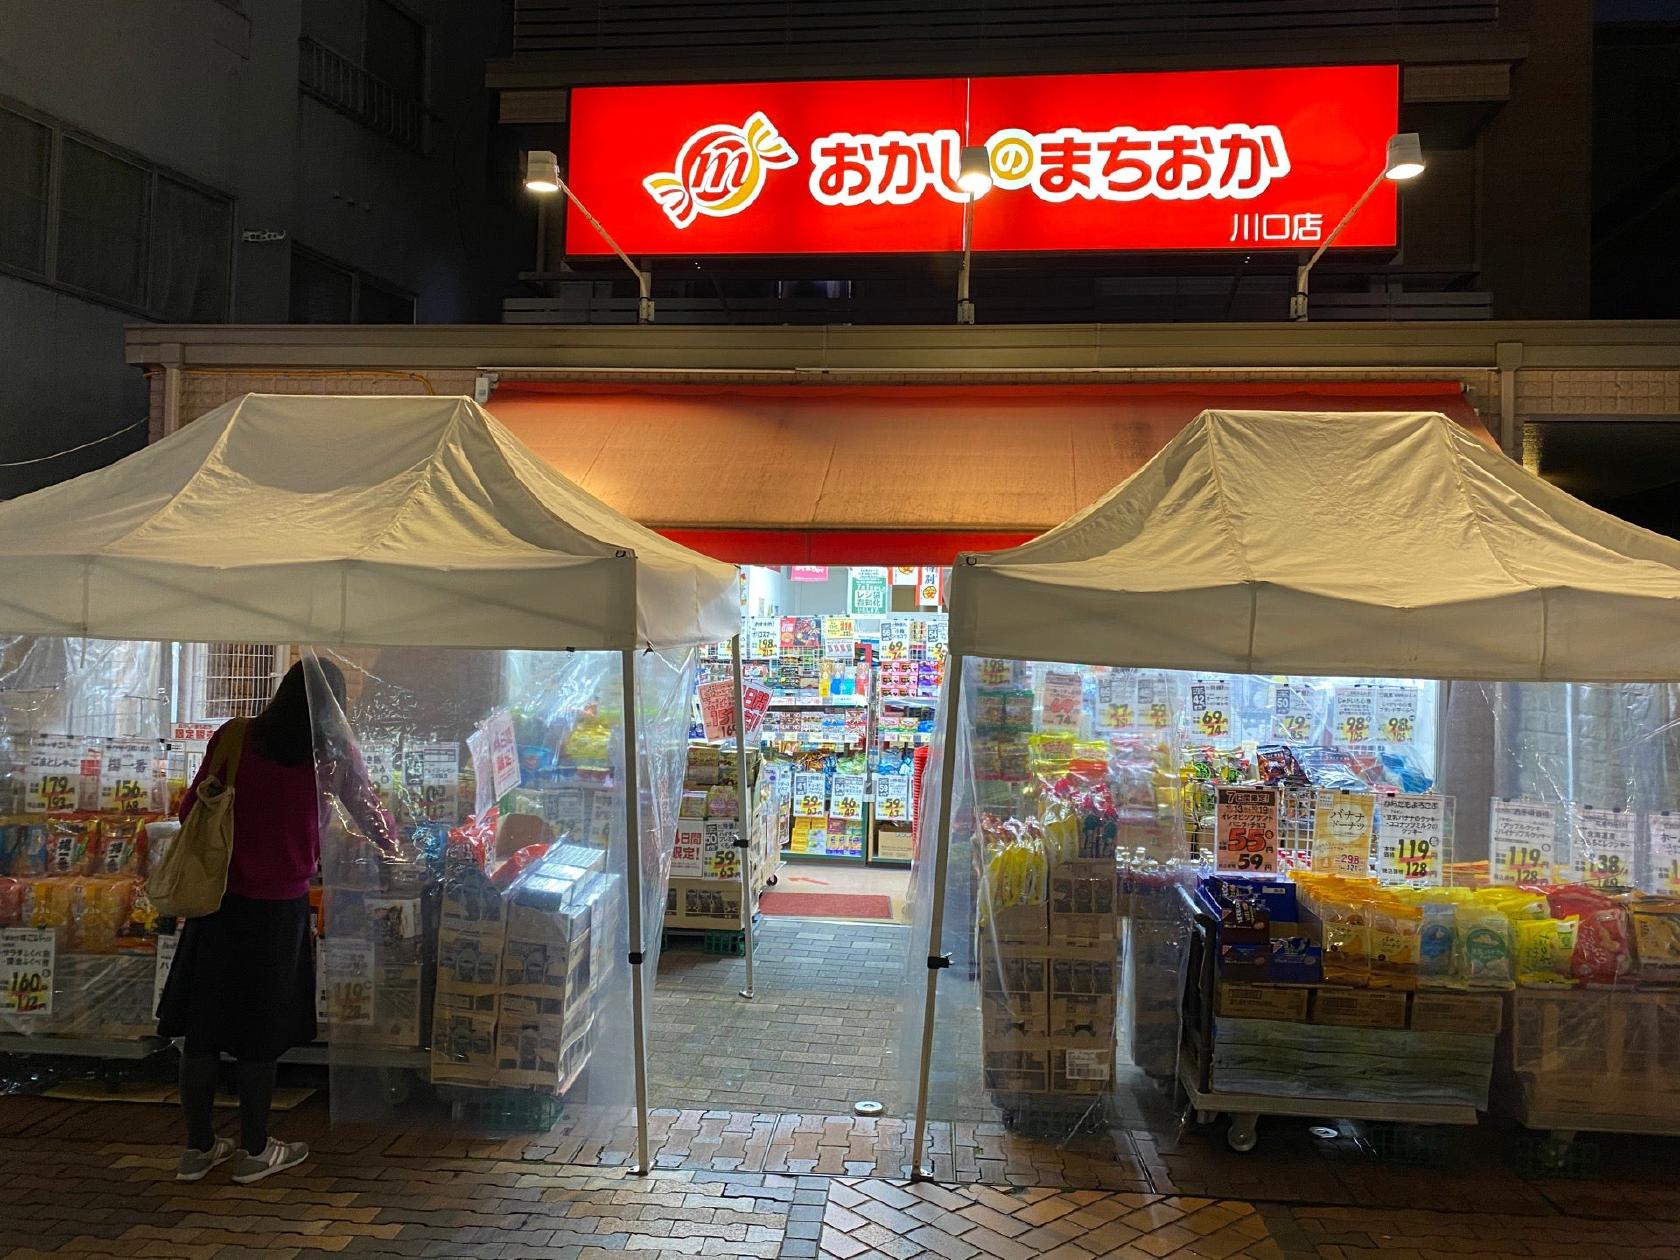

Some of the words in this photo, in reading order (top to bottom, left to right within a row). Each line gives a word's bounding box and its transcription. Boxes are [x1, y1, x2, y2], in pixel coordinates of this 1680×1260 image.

[815, 129, 1284, 201] おかしのまちおか
[1229, 212, 1323, 242] 川口店
[759, 639, 773, 648] 198
[889, 641, 903, 651] 69
[1193, 694, 1205, 706] 42
[1277, 699, 1288, 709] 50
[1202, 710, 1222, 725] 69
[1347, 717, 1365, 732] 98
[42, 776, 68, 796] 179
[115, 780, 140, 798] 156
[804, 796, 818, 806] 59
[841, 797, 856, 808] 46
[886, 799, 900, 808] 59
[1330, 809, 1365, 822] バナナ
[1228, 828, 1266, 852] 55
[1399, 839, 1430, 859] 119
[1510, 846, 1541, 867] 119
[715, 850, 735, 865] 59
[1238, 854, 1263, 869] 59
[1341, 854, 1360, 864] 298
[720, 867, 734, 878] 63
[1406, 862, 1427, 877] 128
[1517, 869, 1538, 884] 128
[12, 972, 41, 992] 160
